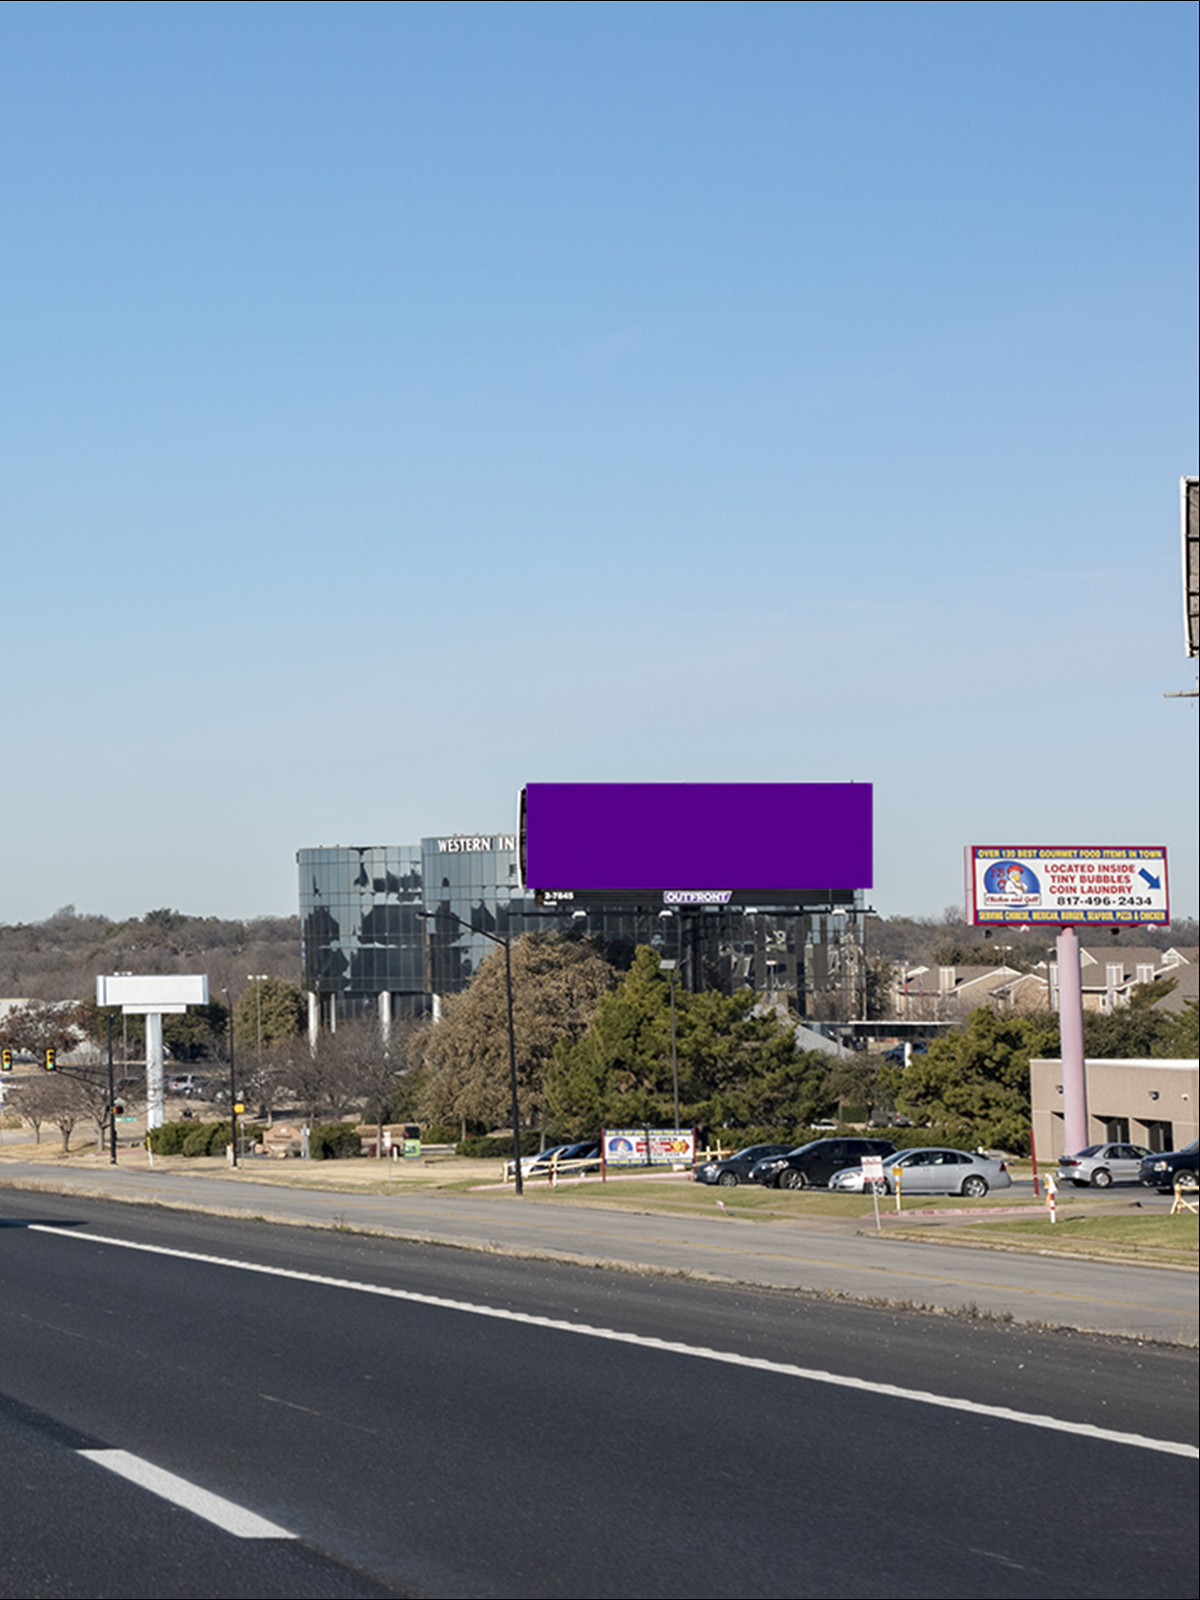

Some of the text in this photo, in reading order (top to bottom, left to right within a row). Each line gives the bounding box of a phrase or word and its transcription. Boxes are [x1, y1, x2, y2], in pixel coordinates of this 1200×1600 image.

[437, 837, 517, 852] WESTERN IN
[978, 849, 1000, 858] OVER
[1017, 849, 1038, 858] BEST
[1039, 849, 1077, 858] GOURMET
[1080, 849, 1101, 858] FOOD
[1103, 849, 1127, 858] ITEMS
[1128, 849, 1137, 858] IN
[1139, 849, 1162, 858] TOWN
[1044, 864, 1135, 873] LOCATED INSIDE
[1050, 875, 1131, 884] TINY BUBBLES
[1049, 885, 1133, 894] COIN LAUNDRY
[665, 891, 731, 903] OUTFRONT
[1057, 896, 1152, 906] 817-496-2434
